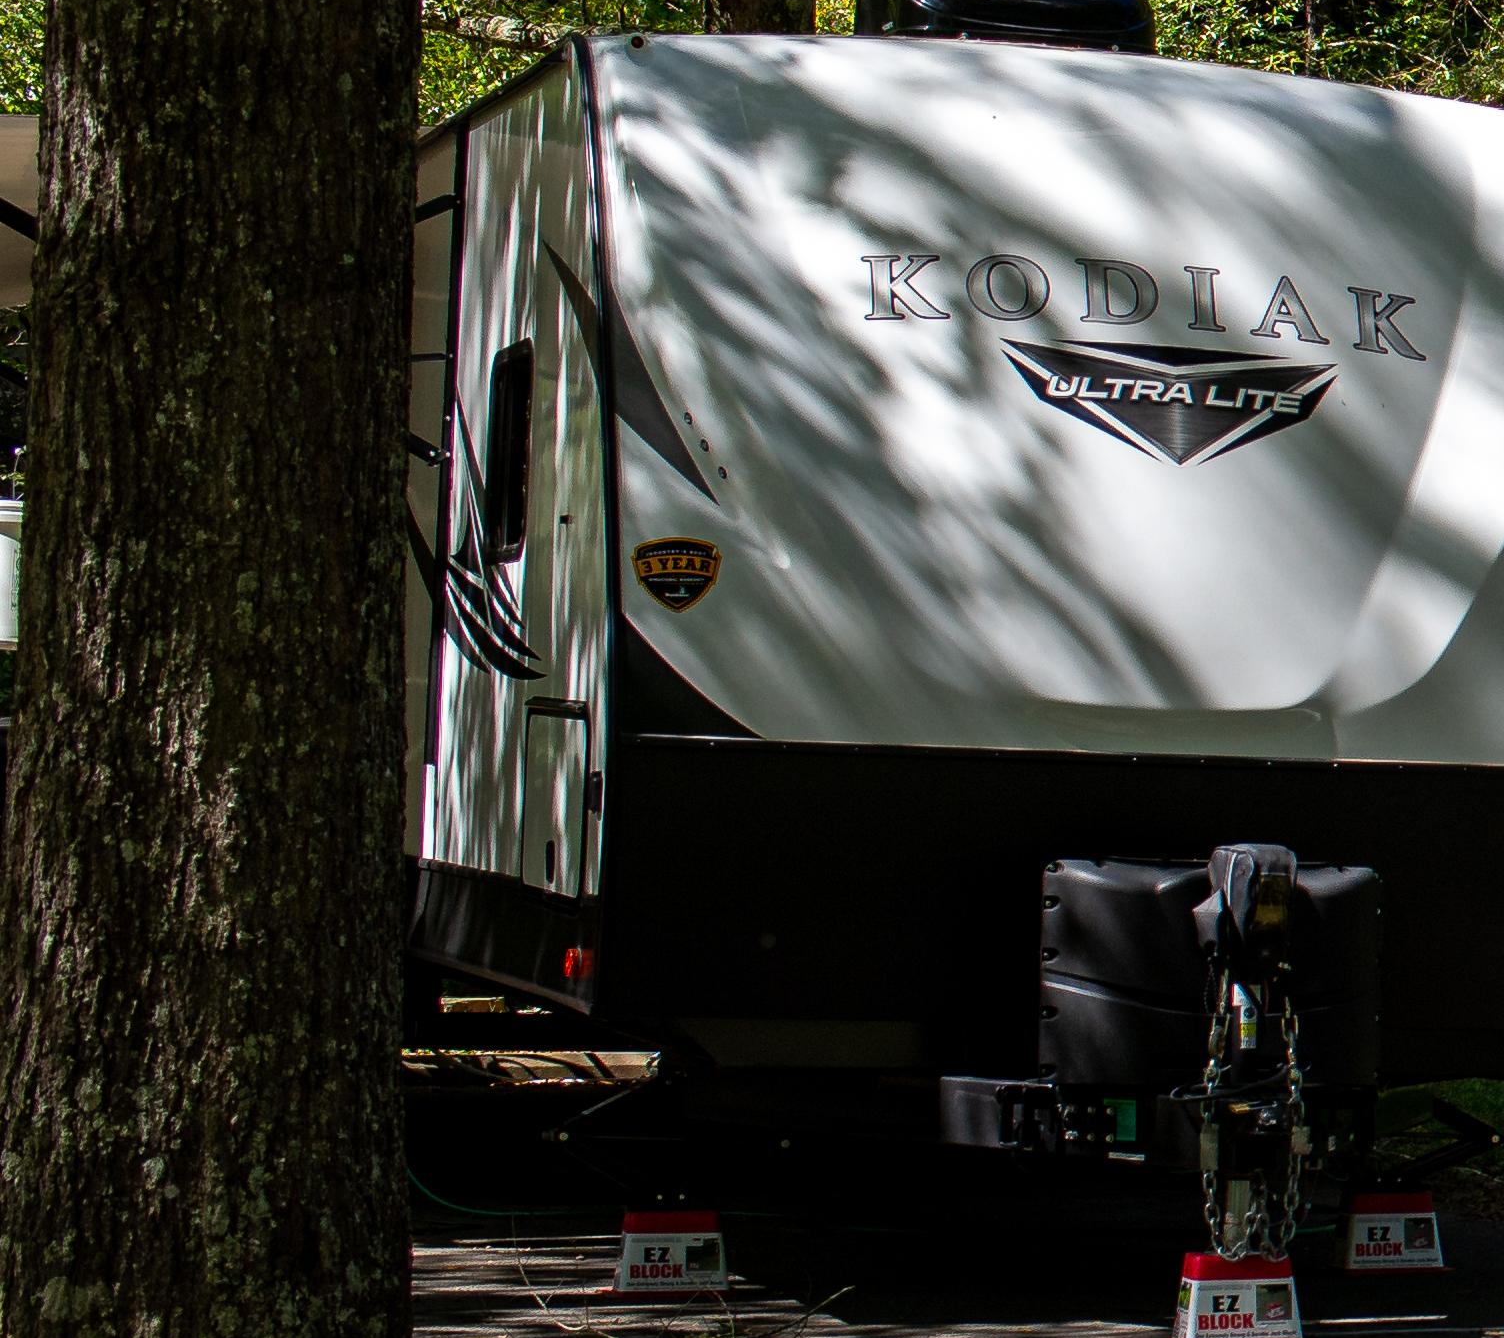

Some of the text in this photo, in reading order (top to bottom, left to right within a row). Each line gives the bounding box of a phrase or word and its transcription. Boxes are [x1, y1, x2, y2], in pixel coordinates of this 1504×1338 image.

[861, 254, 1427, 361] KODIAK
[1047, 375, 1303, 414] ULTRA LITE
[641, 557, 712, 574] 3 YEAR
[1367, 1227, 1391, 1242] EZ
[643, 1247, 670, 1263] EZ
[1355, 1242, 1403, 1257] BLOCK
[629, 1264, 683, 1279] BLOCK
[1212, 1294, 1240, 1312] EZ
[1198, 1313, 1255, 1330] BLOCK
